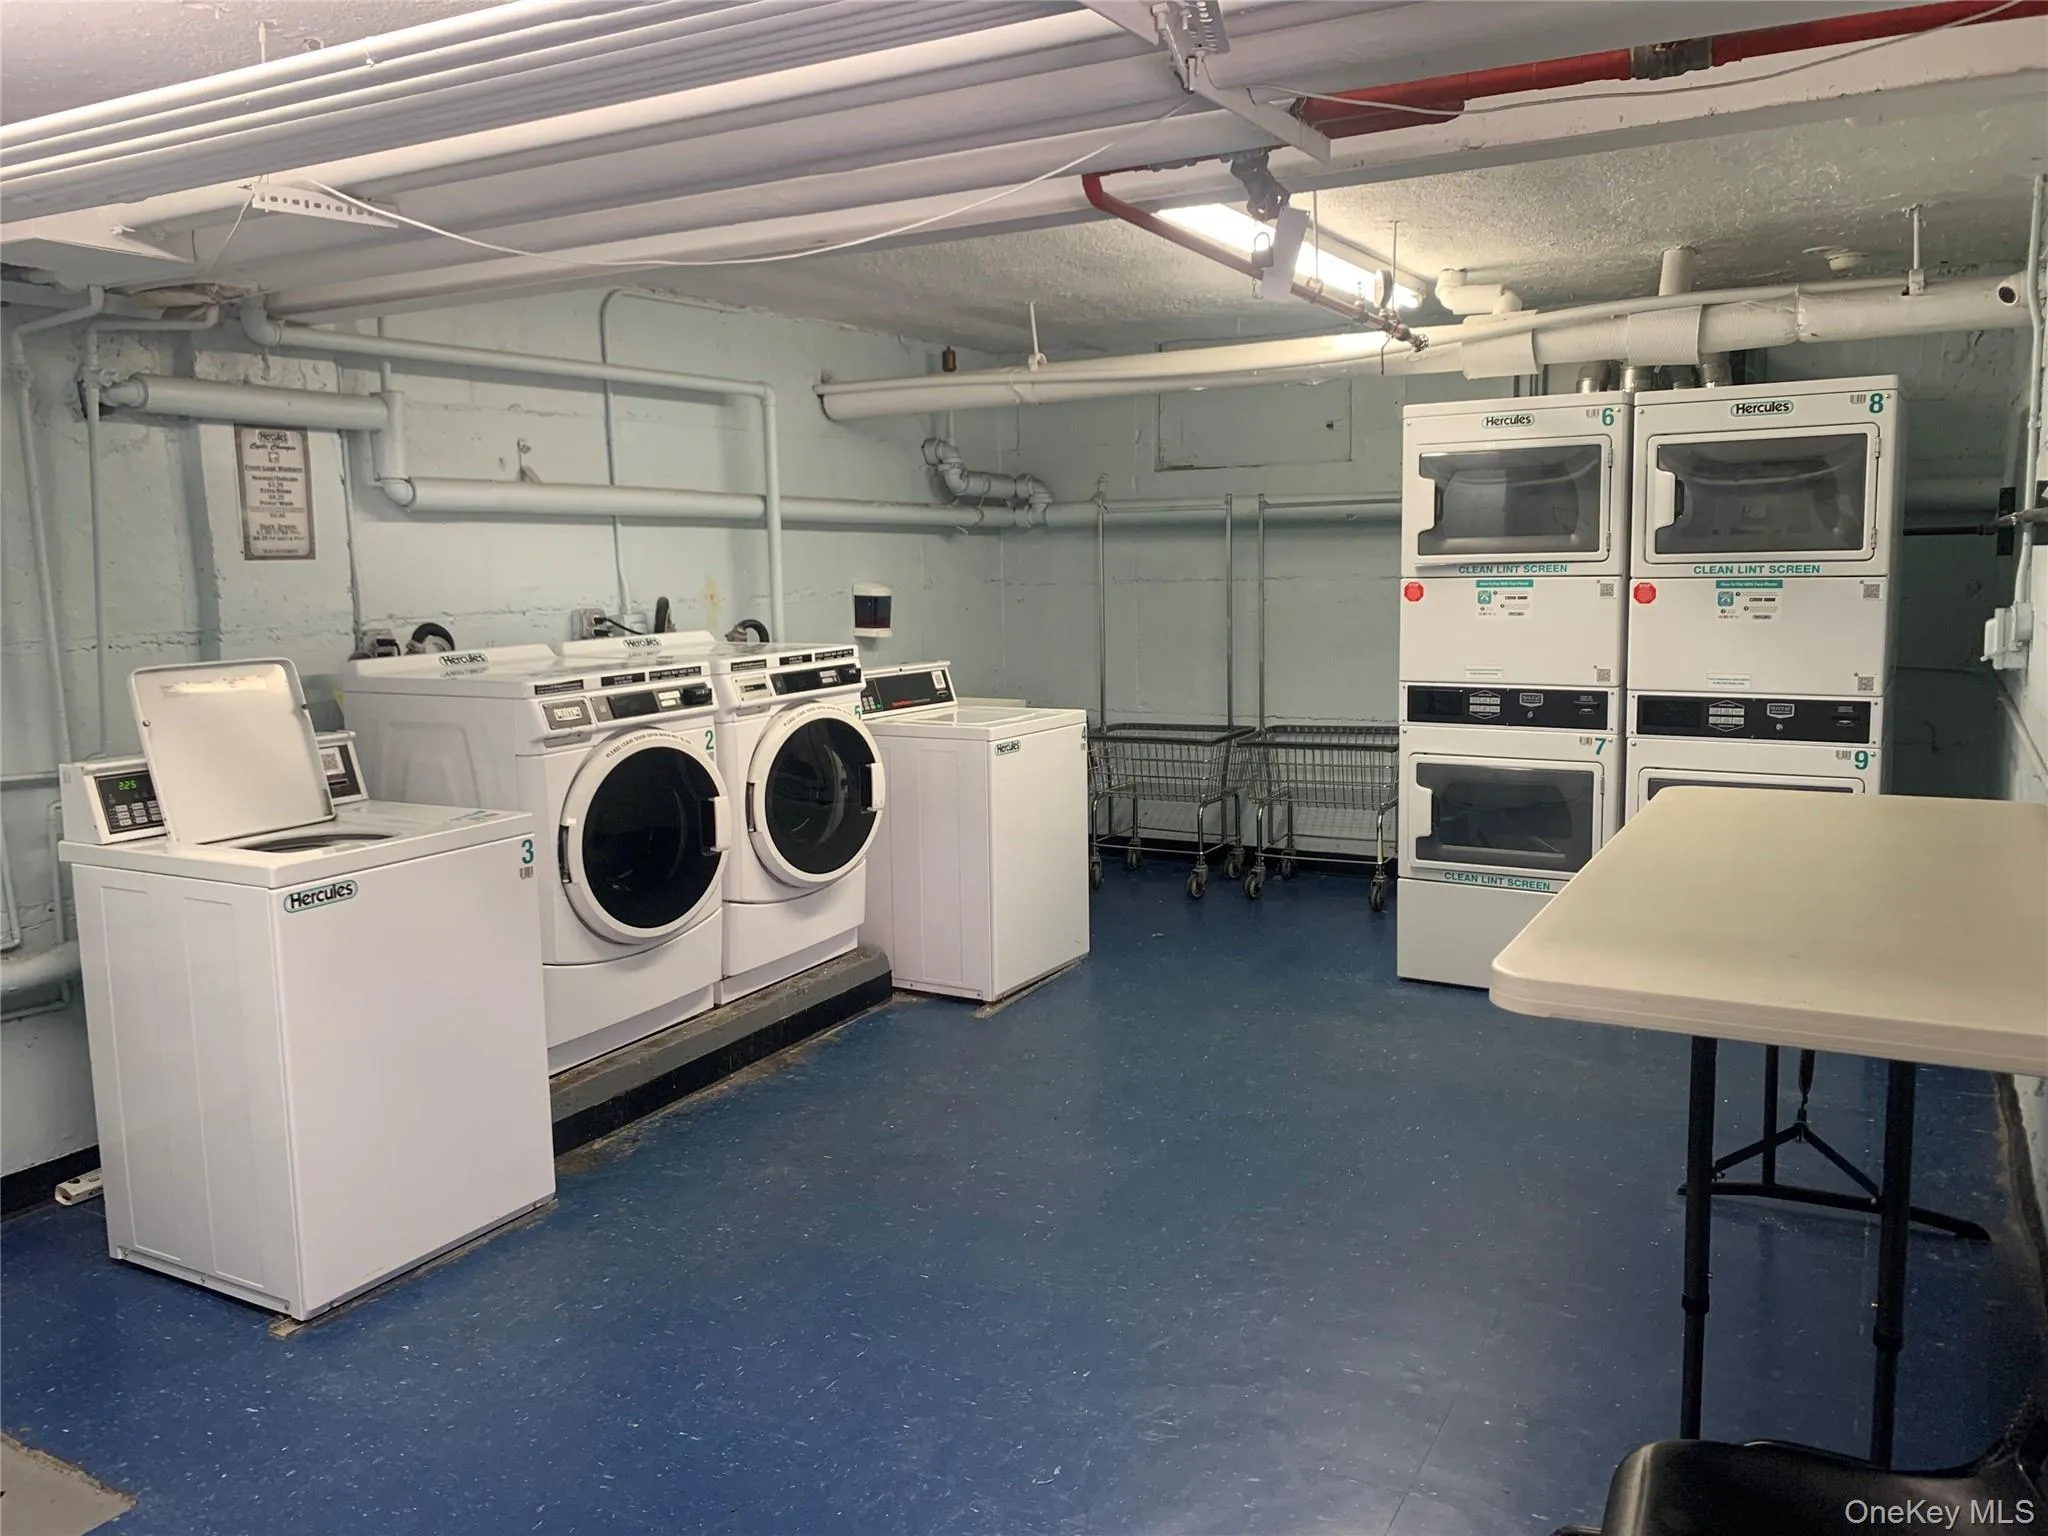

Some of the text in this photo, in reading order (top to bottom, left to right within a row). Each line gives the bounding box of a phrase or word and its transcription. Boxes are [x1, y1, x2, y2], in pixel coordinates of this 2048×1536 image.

[1736, 402, 1790, 414] Hercules
[1869, 393, 1884, 413] 8
[1486, 415, 1532, 426] Hercules
[1602, 408, 1615, 426] 6
[1458, 564, 1568, 574] CLEAN LINT SCREEN
[1693, 564, 1821, 574] CLEAN LINT SCREEN
[625, 638, 660, 648] Hercules
[440, 653, 485, 665] Hercules
[705, 730, 714, 750] 2
[1081, 726, 1087, 739] 4
[996, 741, 1020, 753] Hercules
[1594, 737, 1607, 755] 7
[1854, 750, 1869, 770] 9
[522, 839, 534, 864] 3
[1444, 872, 1551, 890] CLEAN LINT SCREEN
[290, 882, 353, 909] Hercules
